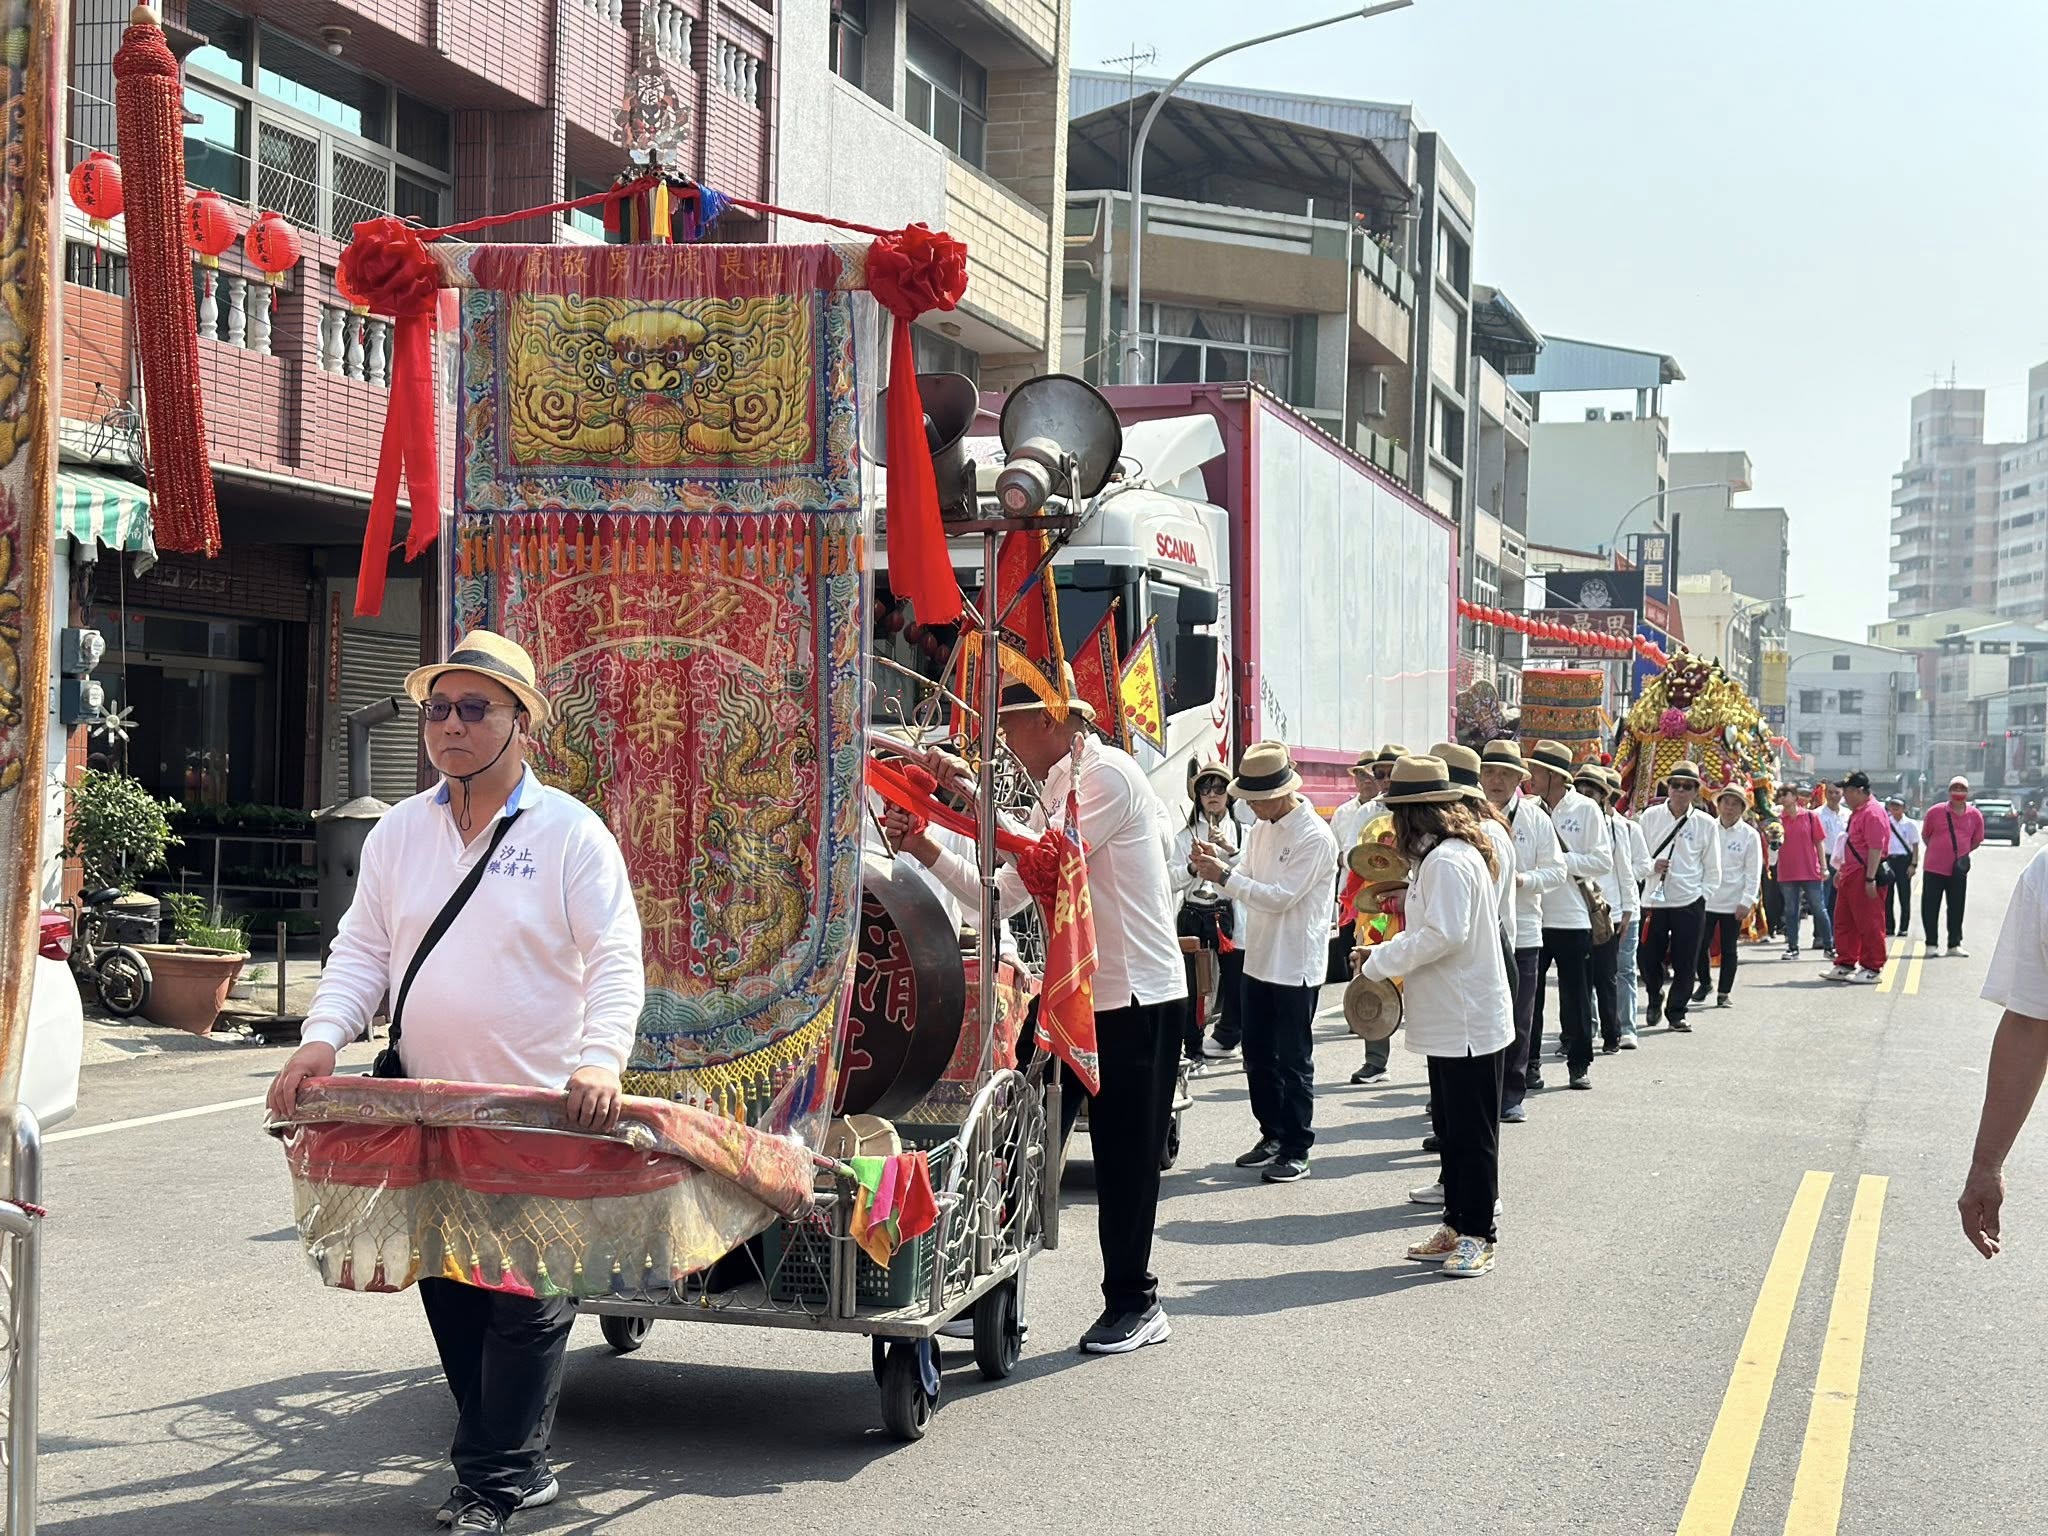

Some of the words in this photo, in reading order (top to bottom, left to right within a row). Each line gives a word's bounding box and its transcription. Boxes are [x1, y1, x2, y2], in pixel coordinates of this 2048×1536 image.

[1156, 532, 1197, 567] SCANIA
[624, 676, 687, 957] 樂清軒
[500, 845, 533, 862] 汐止
[487, 860, 536, 879] 樂清軒
